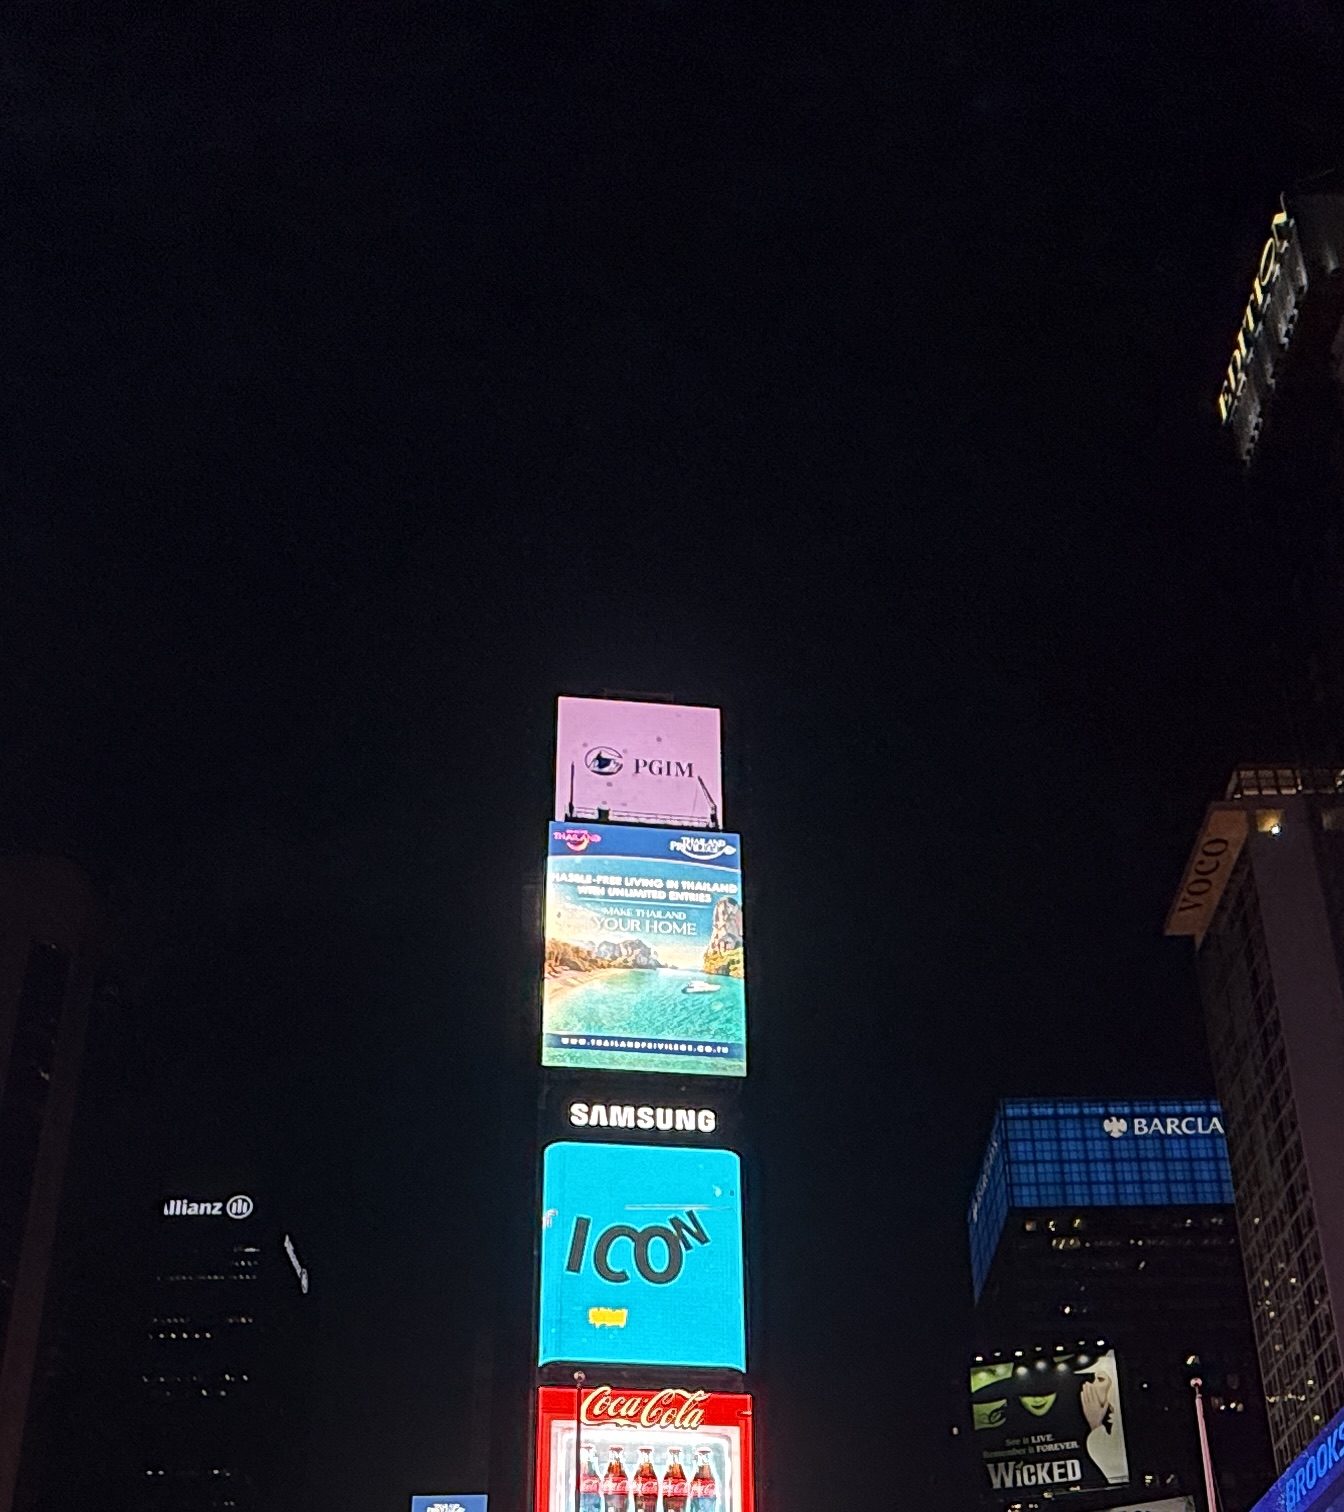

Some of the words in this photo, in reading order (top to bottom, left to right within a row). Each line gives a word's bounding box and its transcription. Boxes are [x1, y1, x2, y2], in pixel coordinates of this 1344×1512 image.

[634, 758, 694, 778] PGIM
[554, 832, 601, 843] THAILAND
[680, 836, 726, 848] THAILAND
[577, 886, 605, 896] WITH
[608, 887, 666, 900] UNLIMITED
[669, 891, 712, 903] ENTRIES
[625, 877, 663, 889] LIVING
[667, 880, 679, 890] IN
[681, 881, 738, 894] THAILAND
[604, 907, 633, 917] MAKE
[636, 908, 687, 920] THAILAND
[593, 916, 641, 932] YOUR
[646, 918, 697, 935] HOME
[569, 1103, 716, 1133] SAMSUNG
[1134, 1117, 1225, 1135] BARCLA
[565, 1209, 711, 1285] ICON
[580, 1386, 710, 1429] Coca-Cola
[987, 1459, 1082, 1489] WICKED
